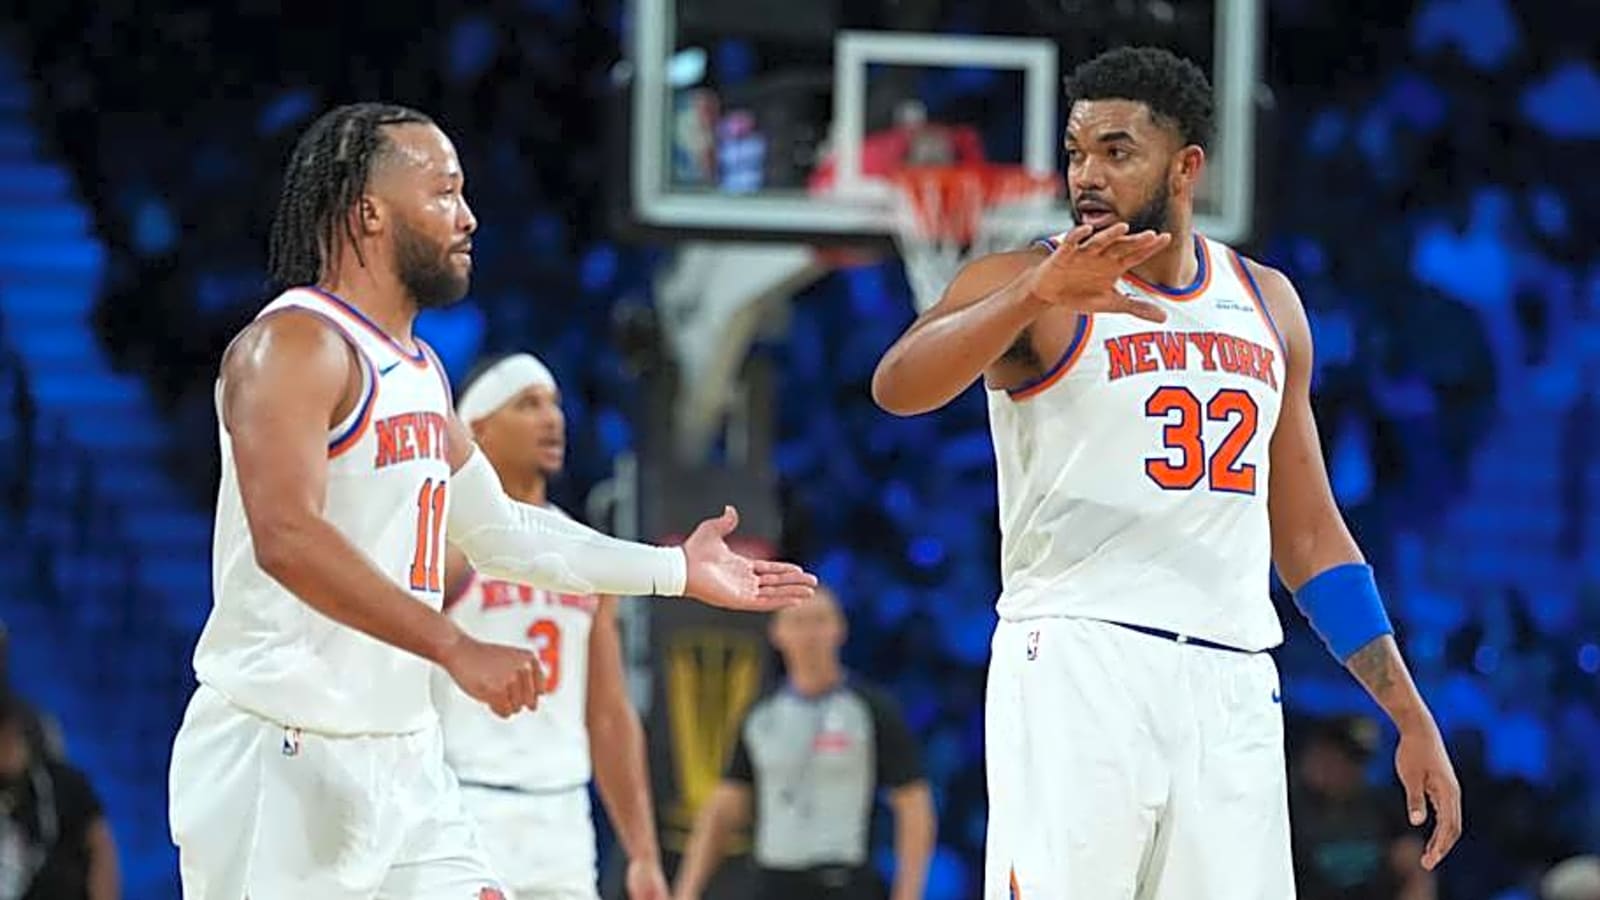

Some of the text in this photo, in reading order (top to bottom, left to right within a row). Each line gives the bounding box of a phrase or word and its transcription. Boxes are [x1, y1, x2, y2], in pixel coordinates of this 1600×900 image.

[1104, 331, 1278, 392] NEW YORK
[1145, 386, 1258, 496] 32
[410, 477, 446, 593] 11
[526, 618, 562, 696] 3
